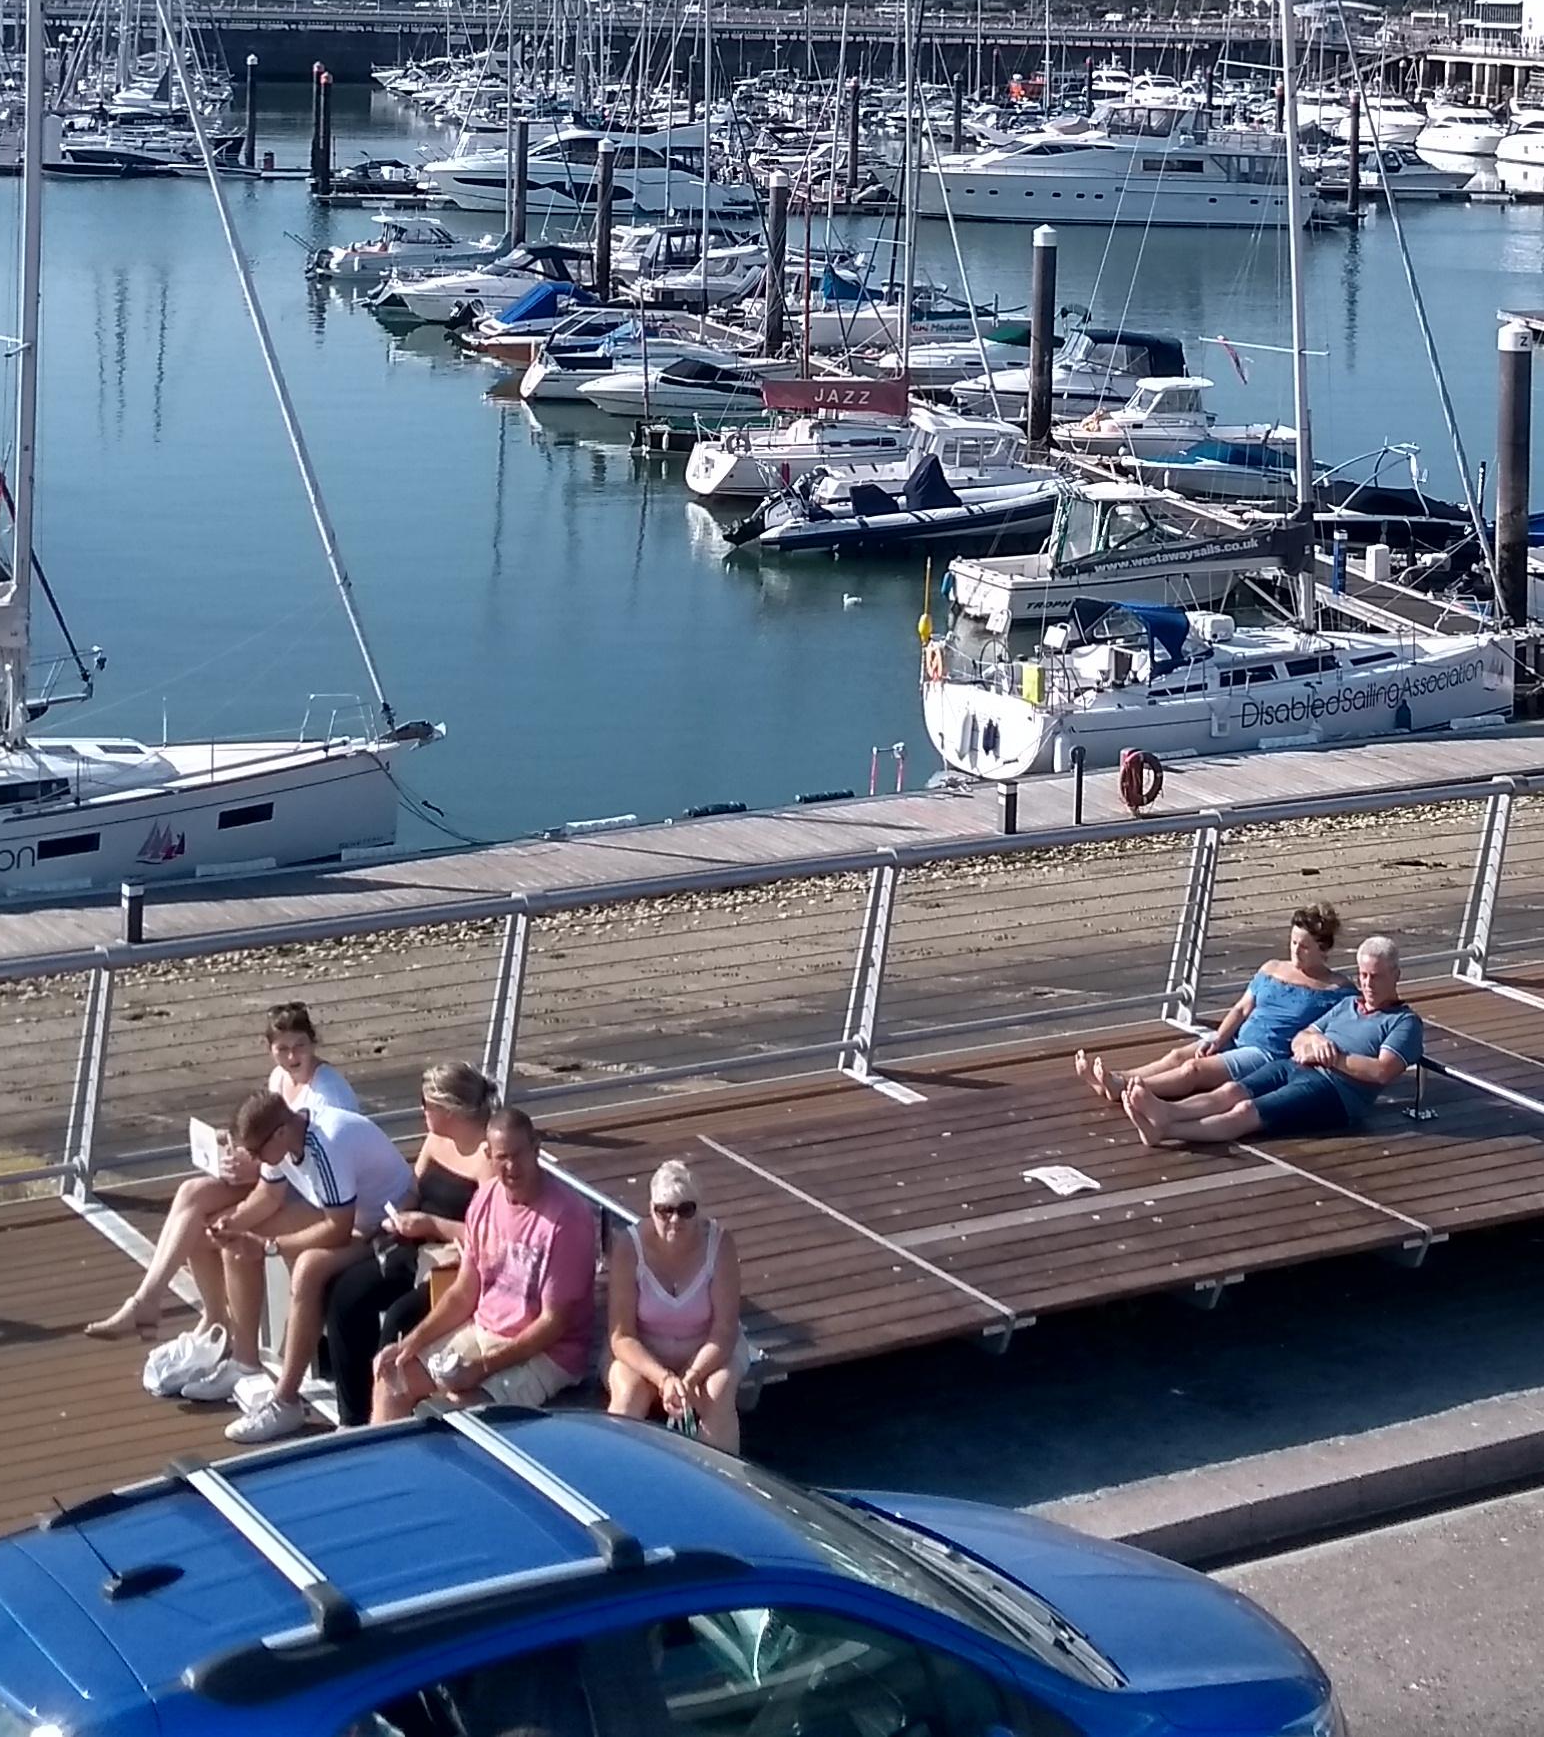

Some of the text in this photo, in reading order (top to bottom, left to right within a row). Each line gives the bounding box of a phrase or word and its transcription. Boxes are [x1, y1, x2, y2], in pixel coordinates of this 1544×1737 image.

[814, 388, 870, 404] JAZZ
[1094, 538, 1258, 573] www.westawaysails.co.uk
[1026, 601, 1072, 609] TROPH
